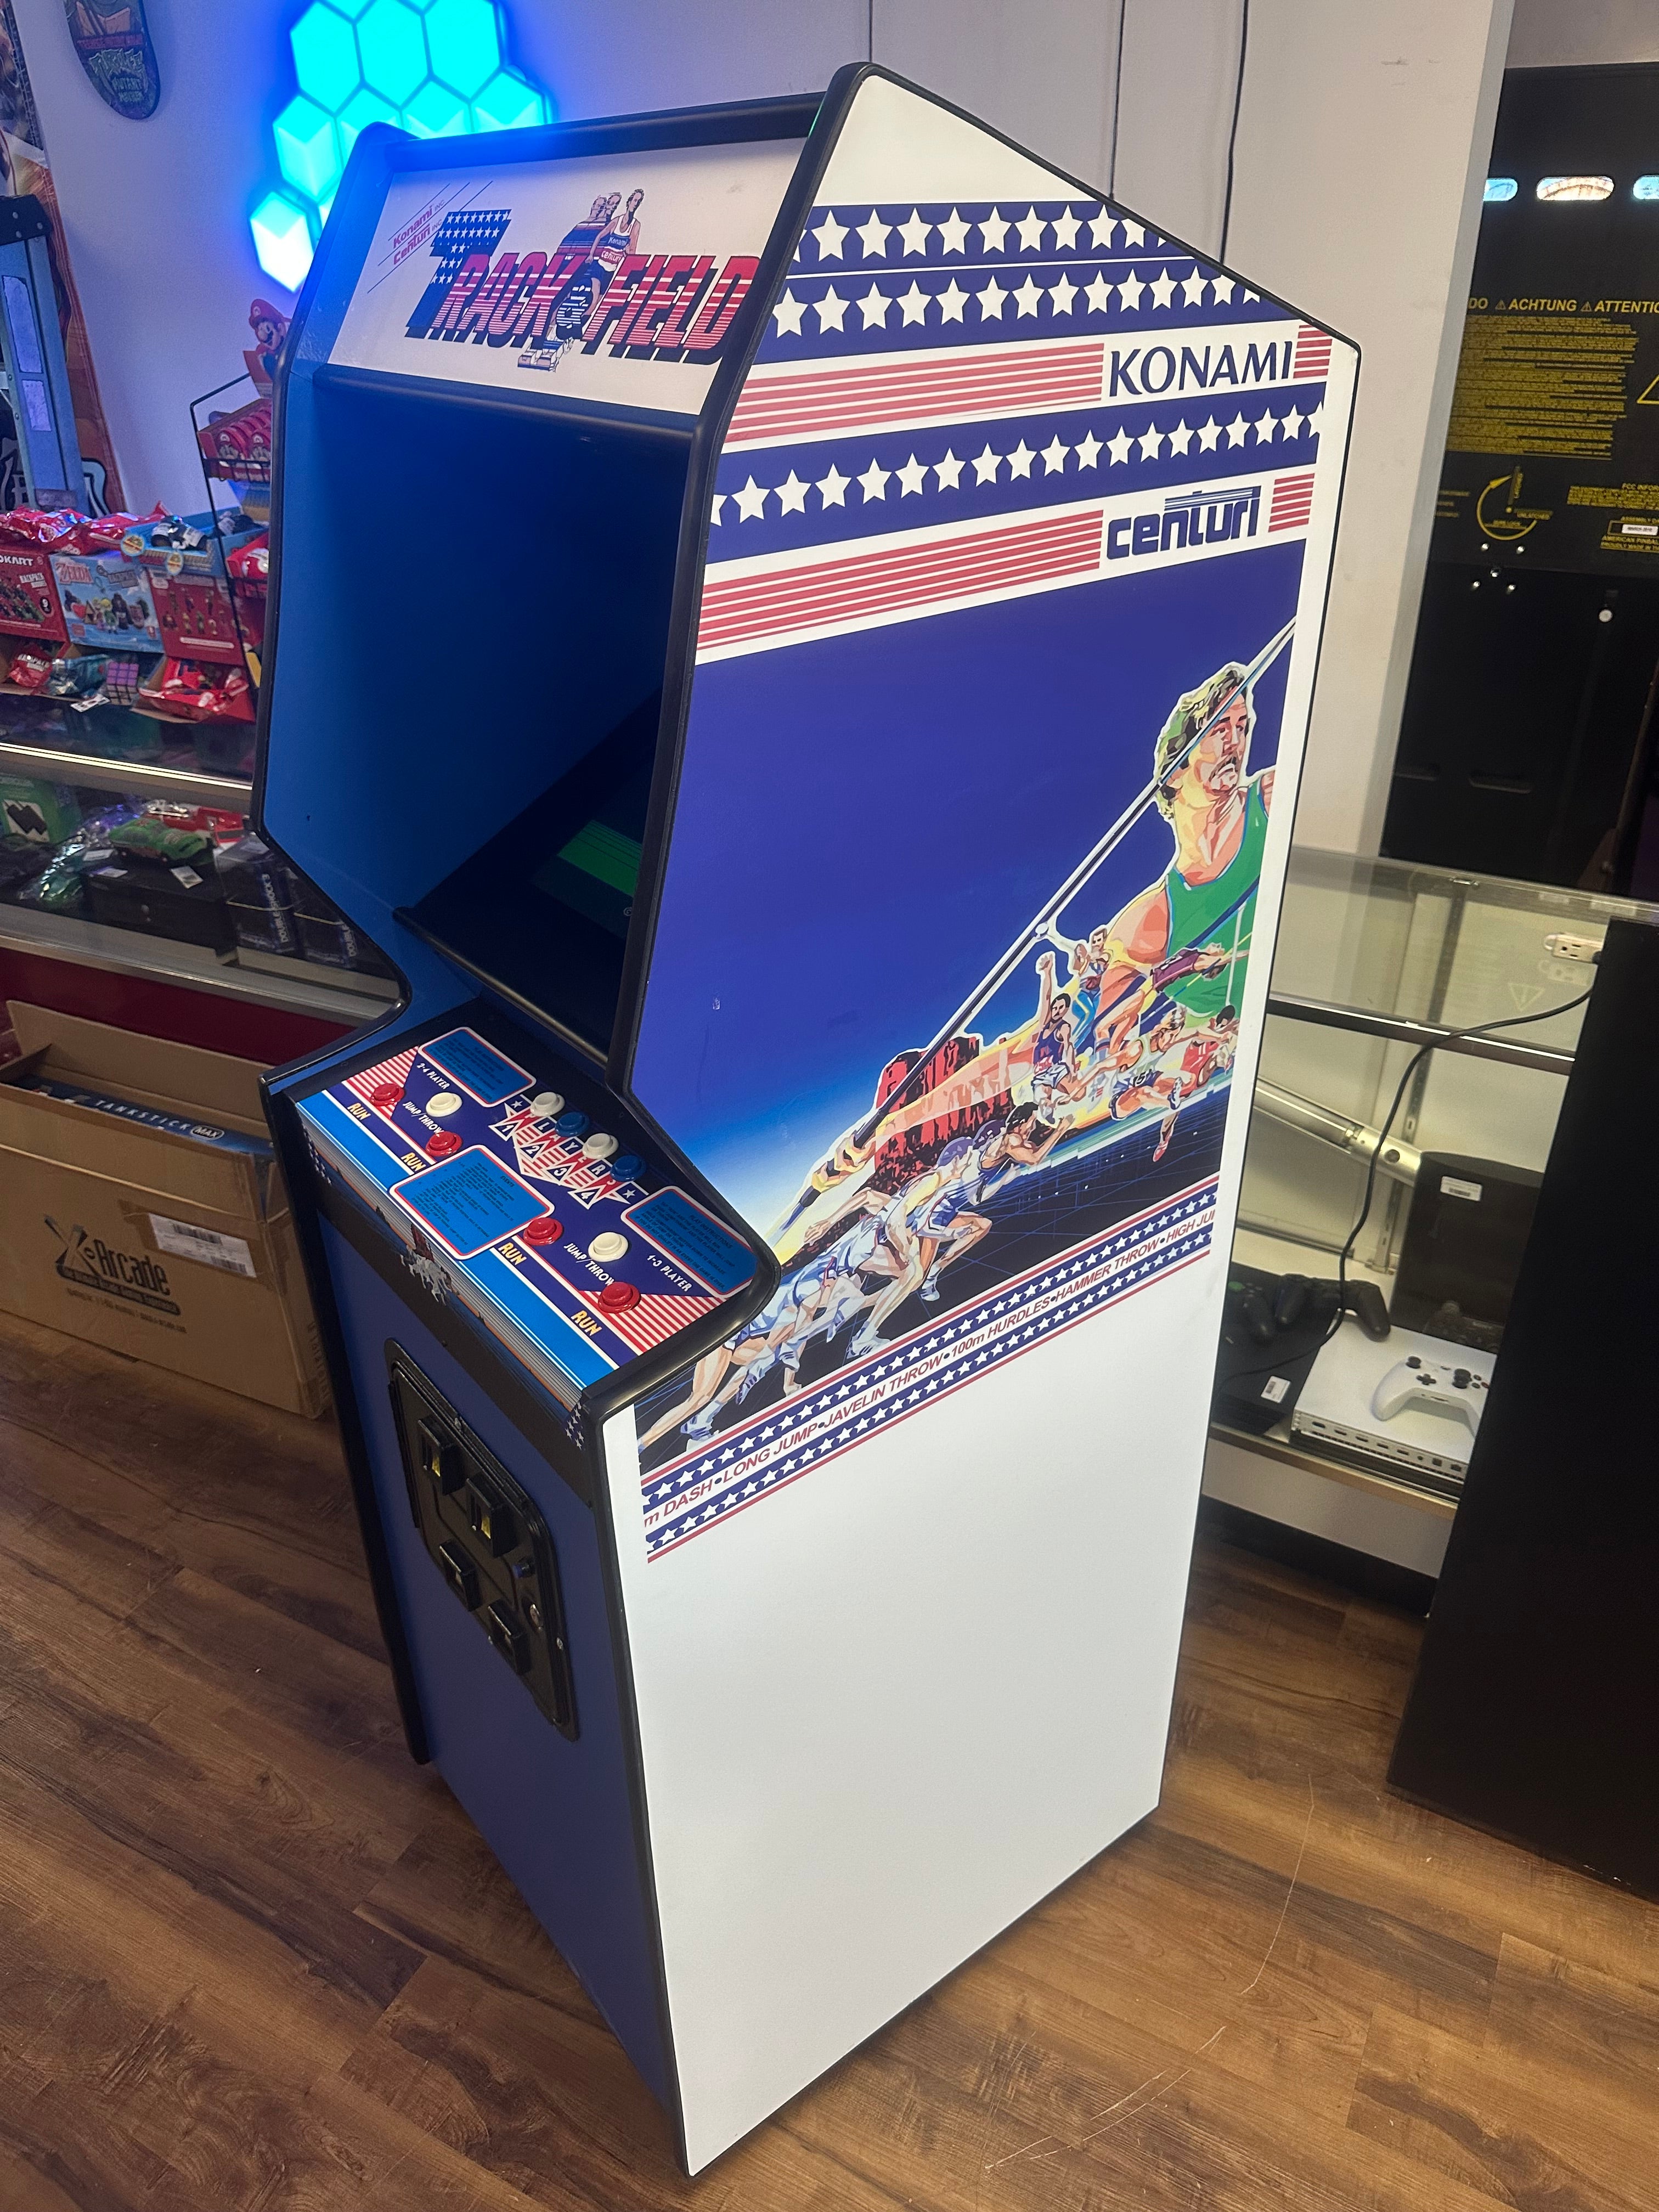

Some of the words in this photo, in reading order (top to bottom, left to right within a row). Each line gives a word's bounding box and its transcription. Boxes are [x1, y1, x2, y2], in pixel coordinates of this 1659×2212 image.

[393, 205, 432, 249] Konami
[608, 236, 628, 246] Konami
[405, 208, 590, 349] TRACK
[580, 255, 761, 365] FIELD
[1508, 298, 1577, 312] ACHTUNG
[1109, 341, 1293, 397] KONAMI
[427, 1071, 450, 1090] PLAYER
[96, 1099, 191, 1131] TANKSTICK
[195, 1126, 219, 1138] MAX
[347, 1102, 371, 1120] RUN
[526, 1146, 541, 1155] 2
[400, 1152, 427, 1171] RUN
[554, 1167, 568, 1176] 3
[581, 1191, 596, 1200] 4
[498, 1242, 528, 1266] RUN
[647, 1255, 662, 1267] 1-3
[660, 1265, 693, 1291] PLAYER
[571, 1310, 602, 1336] RUN
[664, 1478, 713, 1517] DASH
[723, 1448, 770, 1483] LONG
[774, 1423, 818, 1455] JUMP
[824, 1384, 885, 1428] JAVELIN
[890, 1352, 944, 1392] THROW
[952, 1334, 985, 1357] 100m
[988, 1296, 1051, 1339] HURDLES
[1055, 1263, 1112, 1302] HAMMER
[1114, 1238, 1160, 1269] THROW
[1167, 1218, 1196, 1242] HIGH
